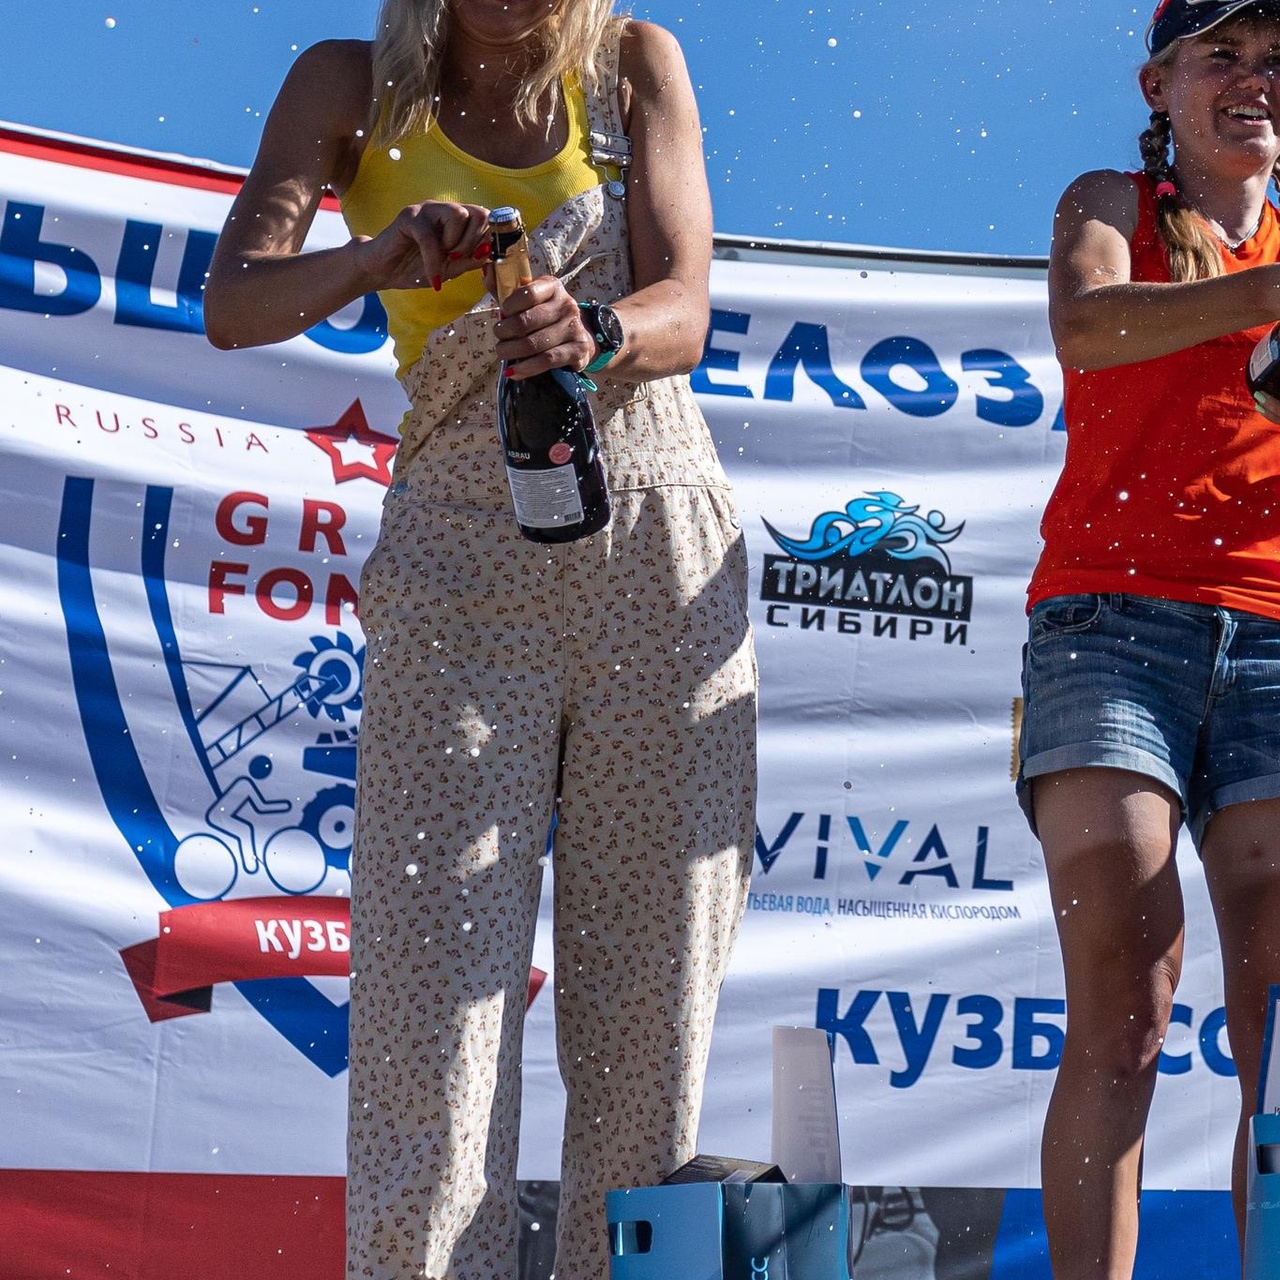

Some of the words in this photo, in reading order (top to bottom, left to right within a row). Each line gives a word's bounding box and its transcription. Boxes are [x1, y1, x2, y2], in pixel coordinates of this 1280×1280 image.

[689, 308, 1066, 431] ЕЛОЗ
[55, 404, 269, 453] RUSSIA
[770, 560, 965, 614] ТРИАТЛОН
[765, 604, 969, 647] СИБИРИ
[838, 898, 927, 920] НАСЫЩЕННАЯ
[931, 904, 1021, 922] КИСЛОРОДОМ
